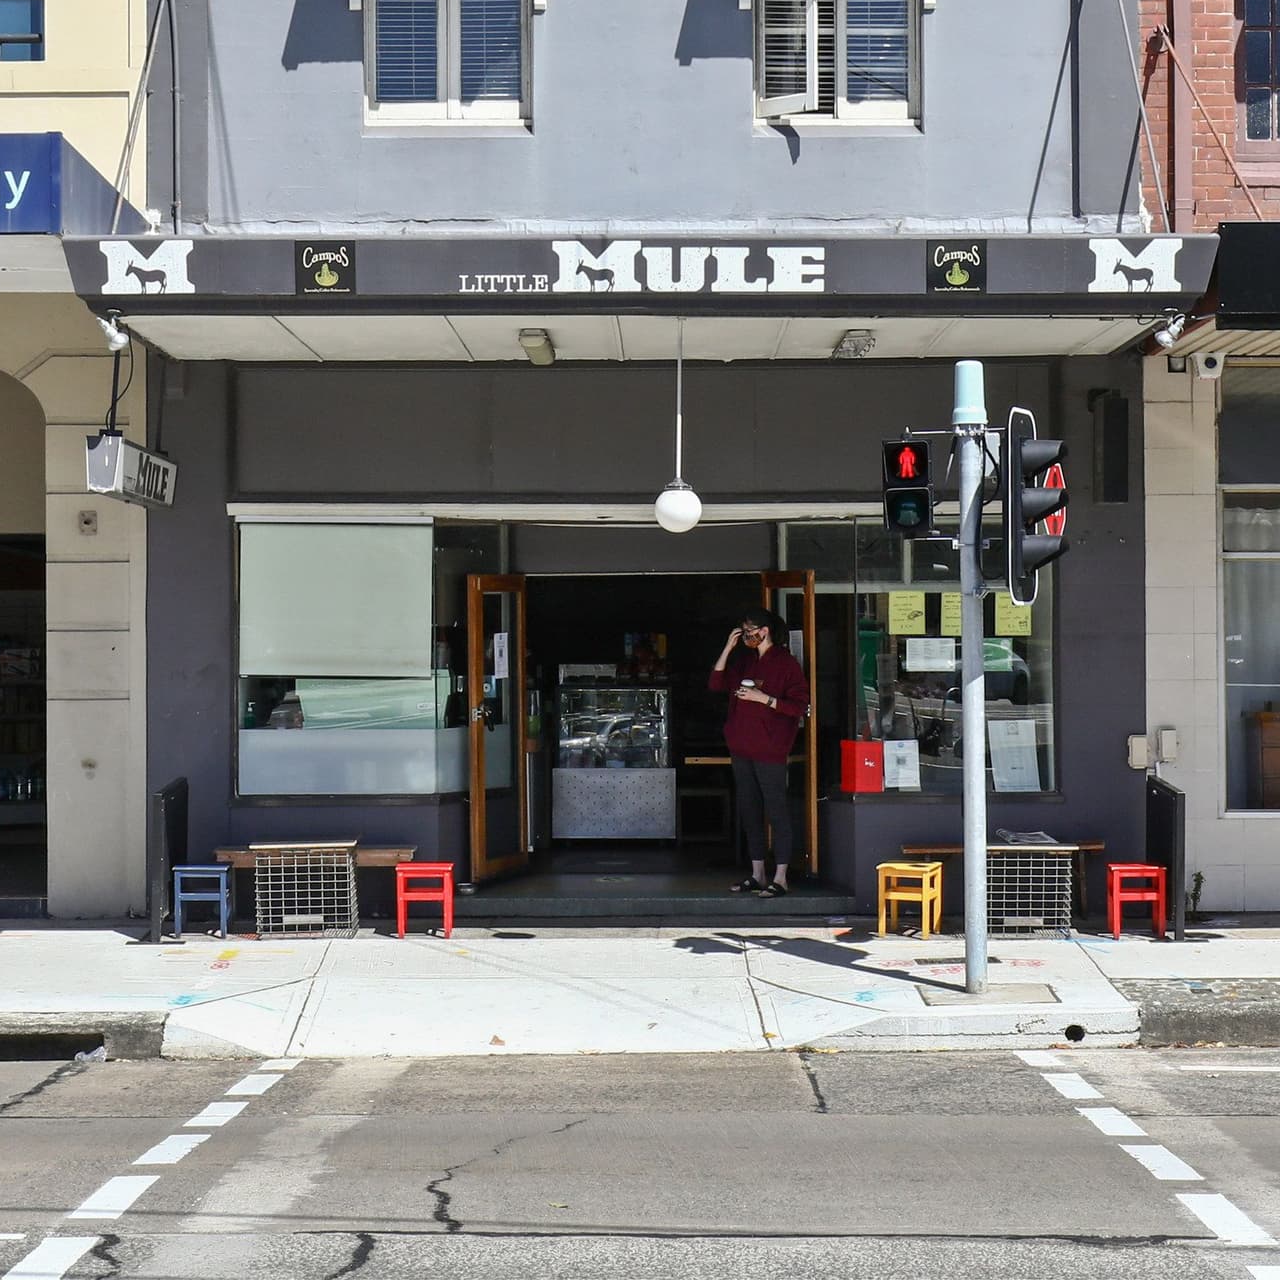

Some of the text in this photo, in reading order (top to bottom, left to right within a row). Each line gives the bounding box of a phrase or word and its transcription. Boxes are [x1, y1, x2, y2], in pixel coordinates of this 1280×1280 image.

[459, 240, 825, 293] LITTLE MULE
[134, 452, 169, 502] MULE
